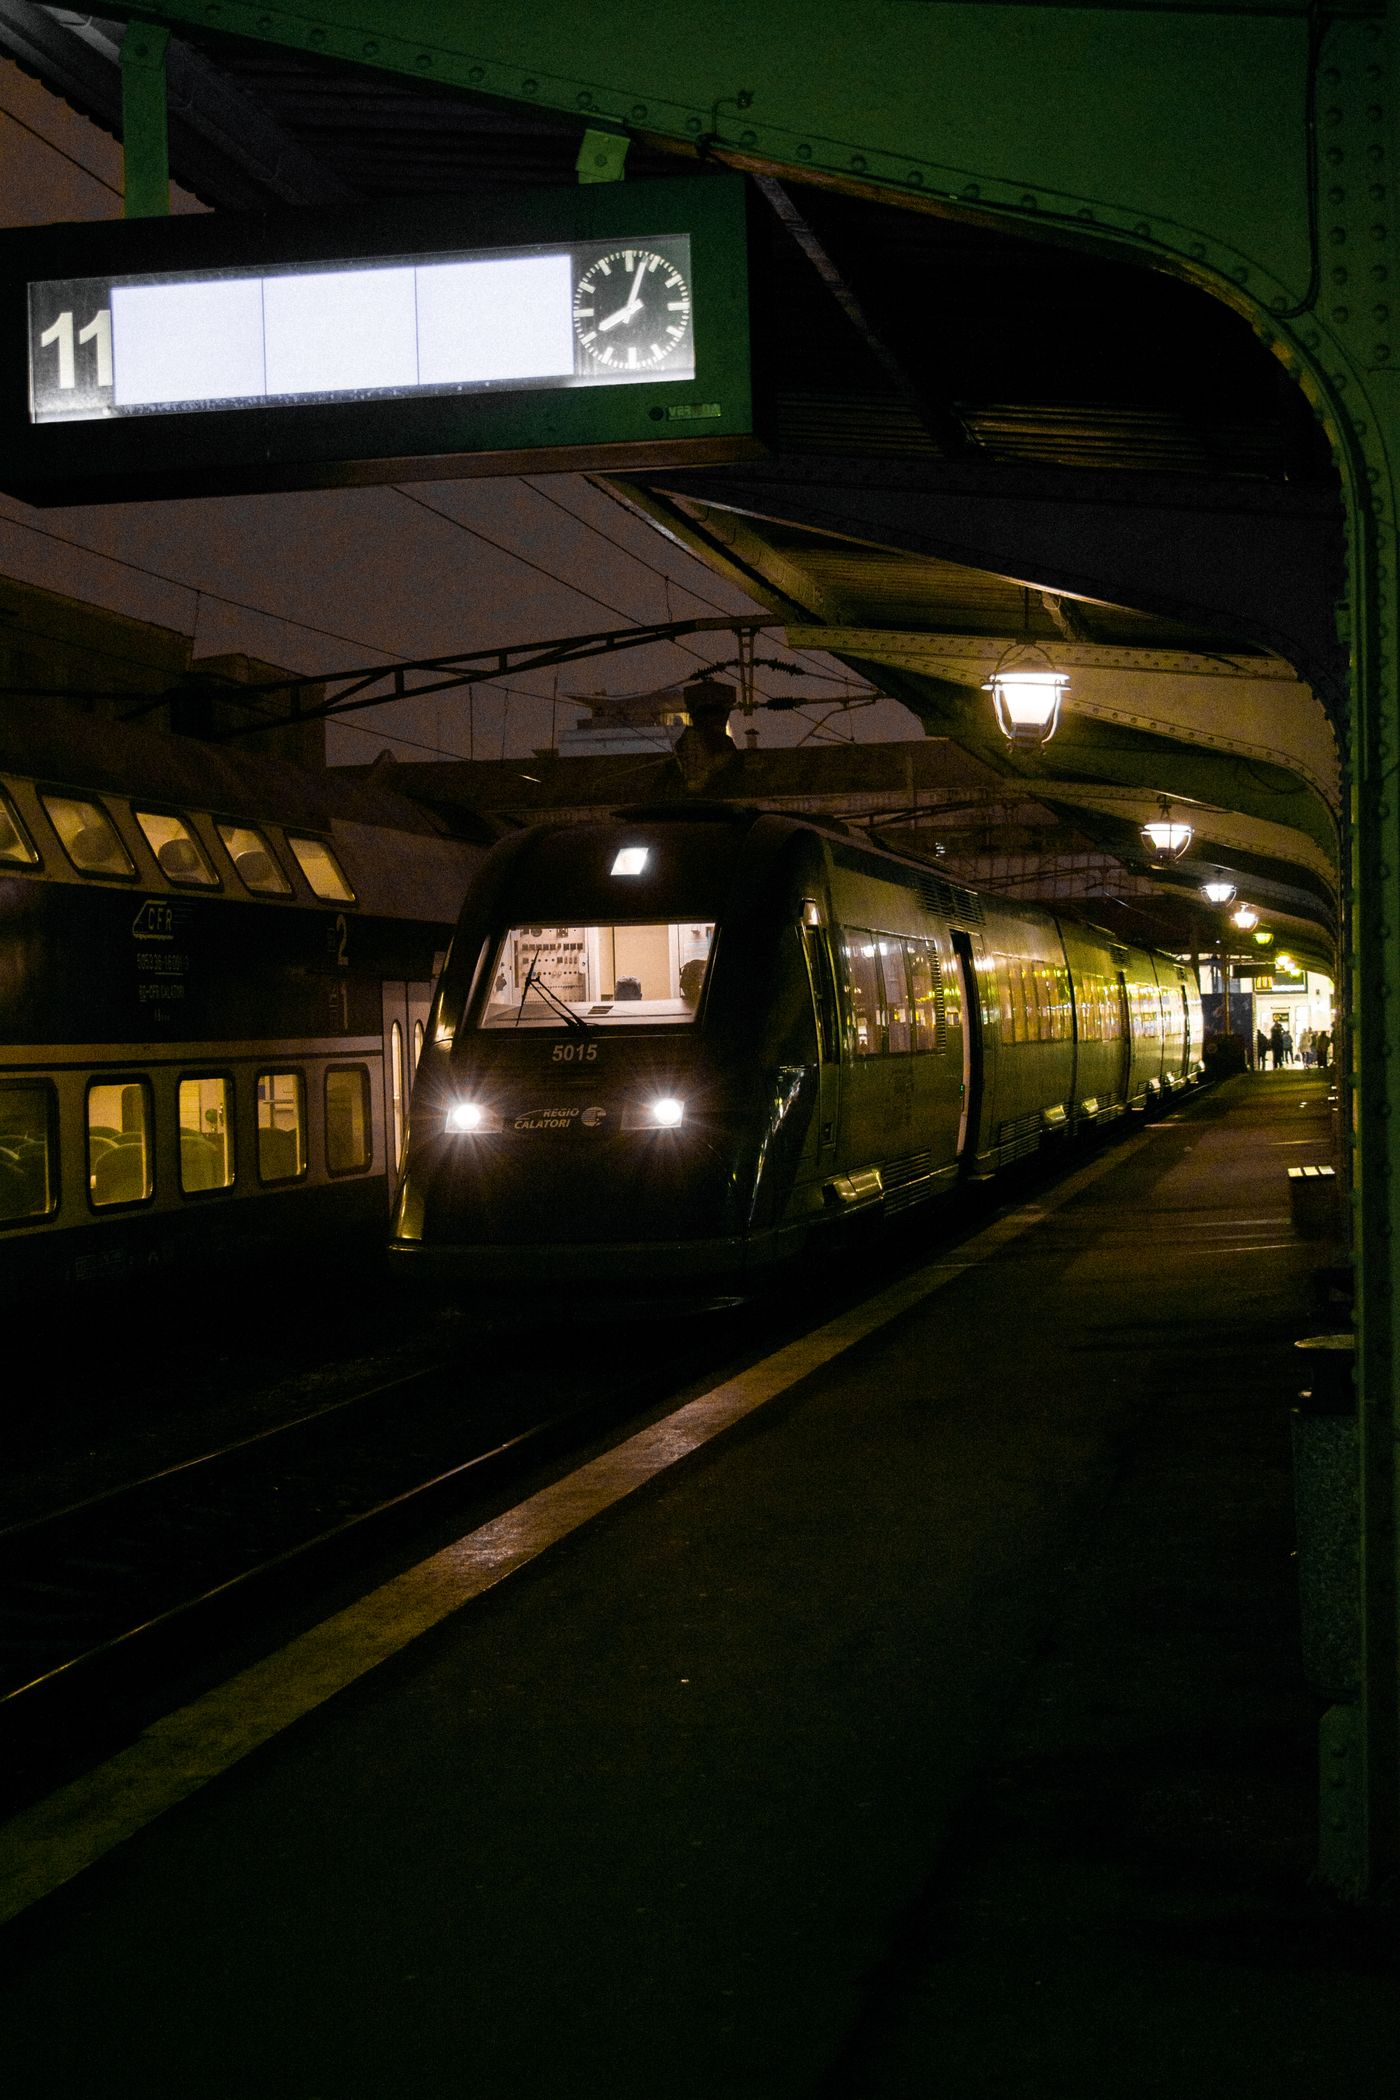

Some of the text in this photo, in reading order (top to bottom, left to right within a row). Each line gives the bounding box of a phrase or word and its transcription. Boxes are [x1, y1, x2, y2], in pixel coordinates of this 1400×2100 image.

[41, 309, 113, 390] 11
[147, 907, 173, 932] CFR
[336, 913, 349, 966] 2
[552, 1043, 598, 1061] 5015
[543, 1107, 580, 1118] REGIO
[514, 1118, 571, 1129] CALATORI
